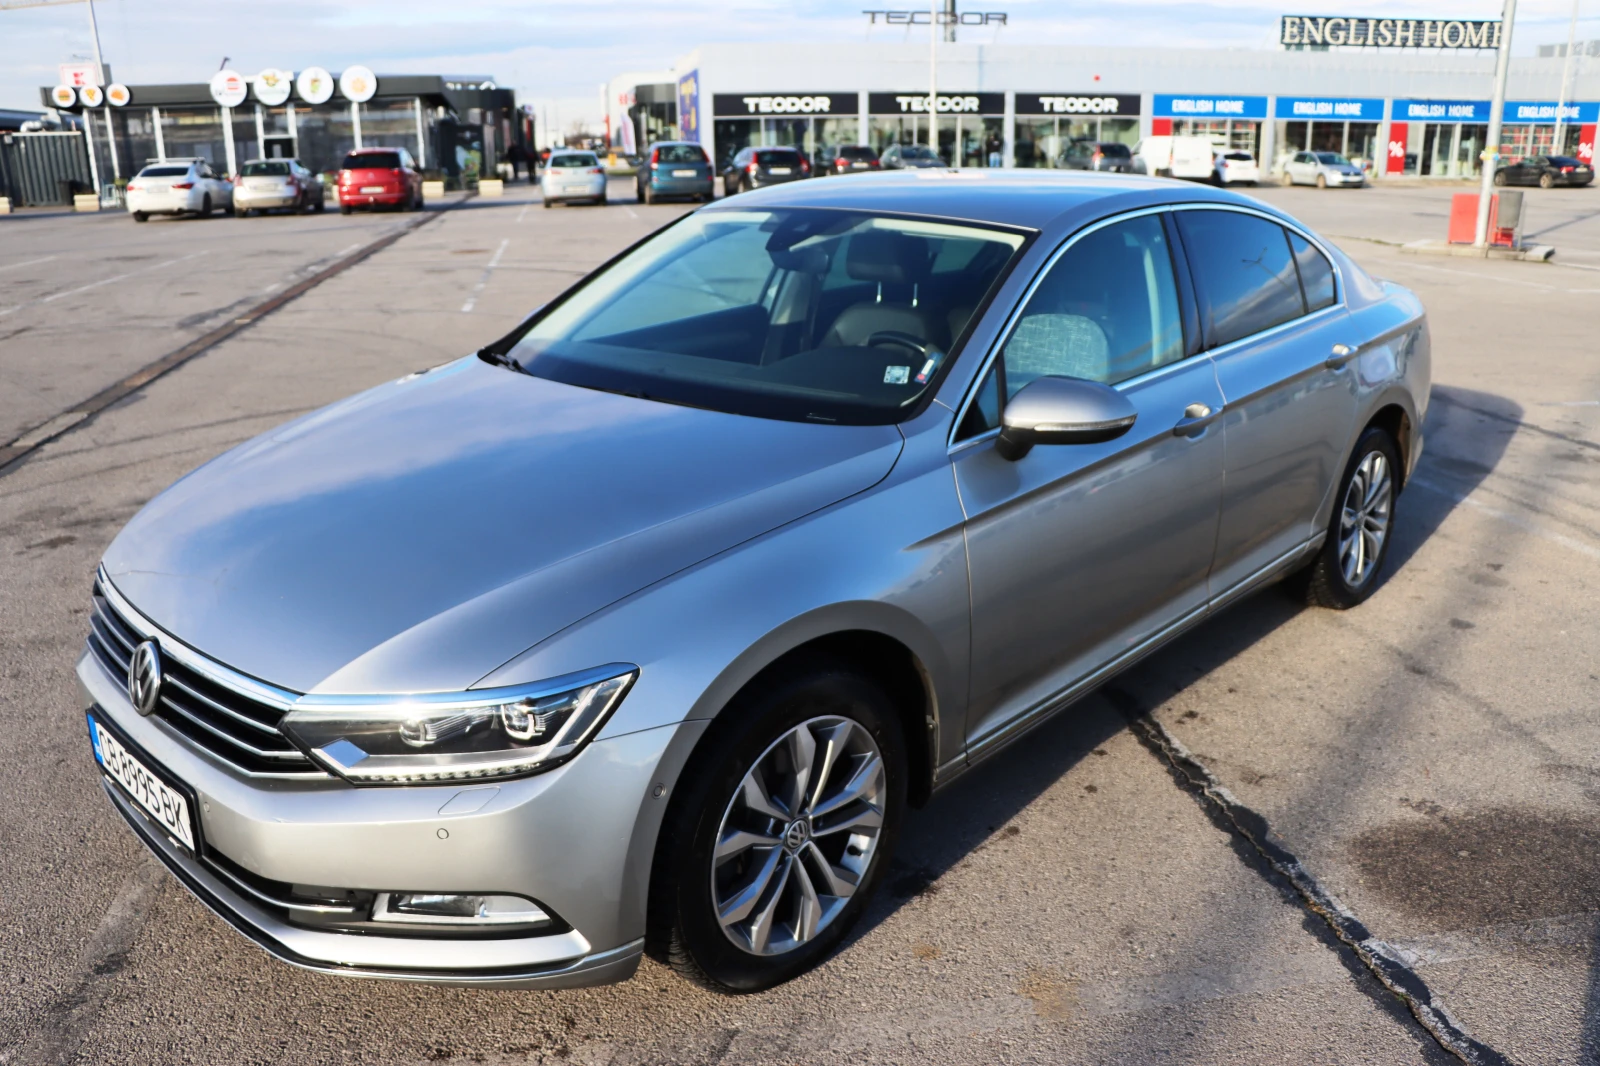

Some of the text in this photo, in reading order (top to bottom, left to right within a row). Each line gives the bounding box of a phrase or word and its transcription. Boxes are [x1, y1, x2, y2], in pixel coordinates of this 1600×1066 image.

[1282, 16, 1416, 47] ENGLISH
[743, 97, 831, 112] TEODOR
[895, 96, 980, 112] TEODOR
[1038, 97, 1119, 113] TEODOR
[1171, 99, 1245, 114] ENGLISH HOME
[1293, 101, 1362, 116] ENGLISH HOME
[1408, 104, 1475, 117] ENGLISH HOME
[1517, 106, 1554, 118] ENGLISH
